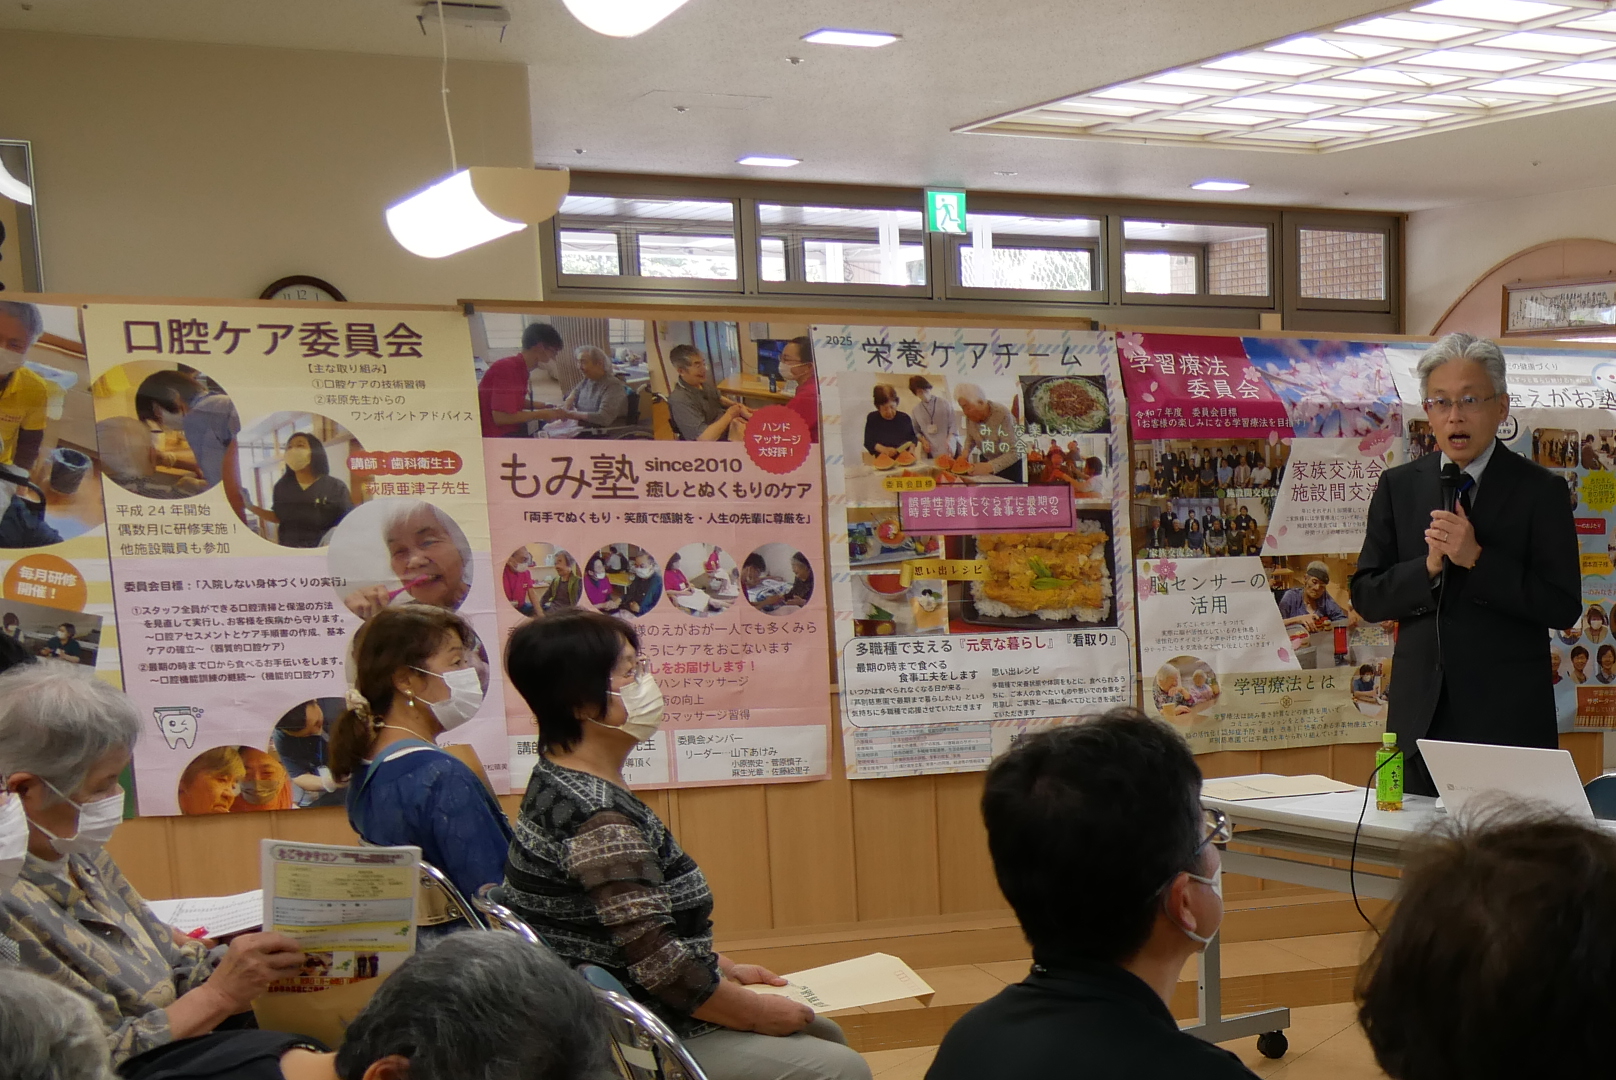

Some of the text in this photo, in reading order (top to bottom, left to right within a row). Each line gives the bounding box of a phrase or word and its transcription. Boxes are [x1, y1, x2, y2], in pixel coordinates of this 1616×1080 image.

[296, 289, 307, 300] 12
[123, 318, 424, 359] 口腔ケア委員会
[825, 336, 853, 346] 2025
[861, 336, 1083, 369] 栄養ケアチーム
[307, 363, 389, 376] 【主な取り組み】
[1129, 350, 1230, 377] 学習療法
[311, 378, 427, 391] ①口腔ケアの技術習得
[1187, 378, 1261, 400] 委員会
[313, 394, 406, 406] ②萩原先生からの
[350, 410, 474, 422] ワンポイントアドバイス
[1191, 407, 1238, 418] 委員会目標
[761, 422, 791, 433] ハンド
[752, 434, 802, 446] マッサージ
[350, 457, 457, 471] 講師：歯科衛生士
[644, 457, 743, 473] since2010
[1291, 459, 1383, 481] 家族交流会
[500, 452, 640, 500] もみ塾
[365, 482, 471, 496] 萩原亜津子先生
[645, 480, 813, 499] 癒しとぬくもりのケア
[885, 479, 934, 489] 委員会目標
[116, 504, 211, 517] 平成 24 年開始
[908, 505, 1060, 517] 時まで美味しく食事を食べる
[522, 511, 812, 526] 「両手でぬくもり・笑顔で感謝を・人生の先輩に尊厳を」
[118, 522, 238, 537] 偶数月に研修実施！
[120, 541, 231, 556] 他施設職員も参加
[19, 565, 77, 588] 毎月研修
[913, 563, 984, 577] 思い出レシピ
[124, 576, 348, 593] 委員会目標：「入院しない身体づくりの実行」
[1149, 573, 1267, 596] 脳センサーの
[1190, 595, 1229, 616] 活用
[855, 659, 948, 673] 最期の時まで食べる
[991, 665, 1041, 677] 思い出レシピ
[898, 669, 979, 683] 食事工夫をします
[1233, 675, 1336, 696] 学習療法とは
[677, 734, 744, 746] 委員会メンバー
